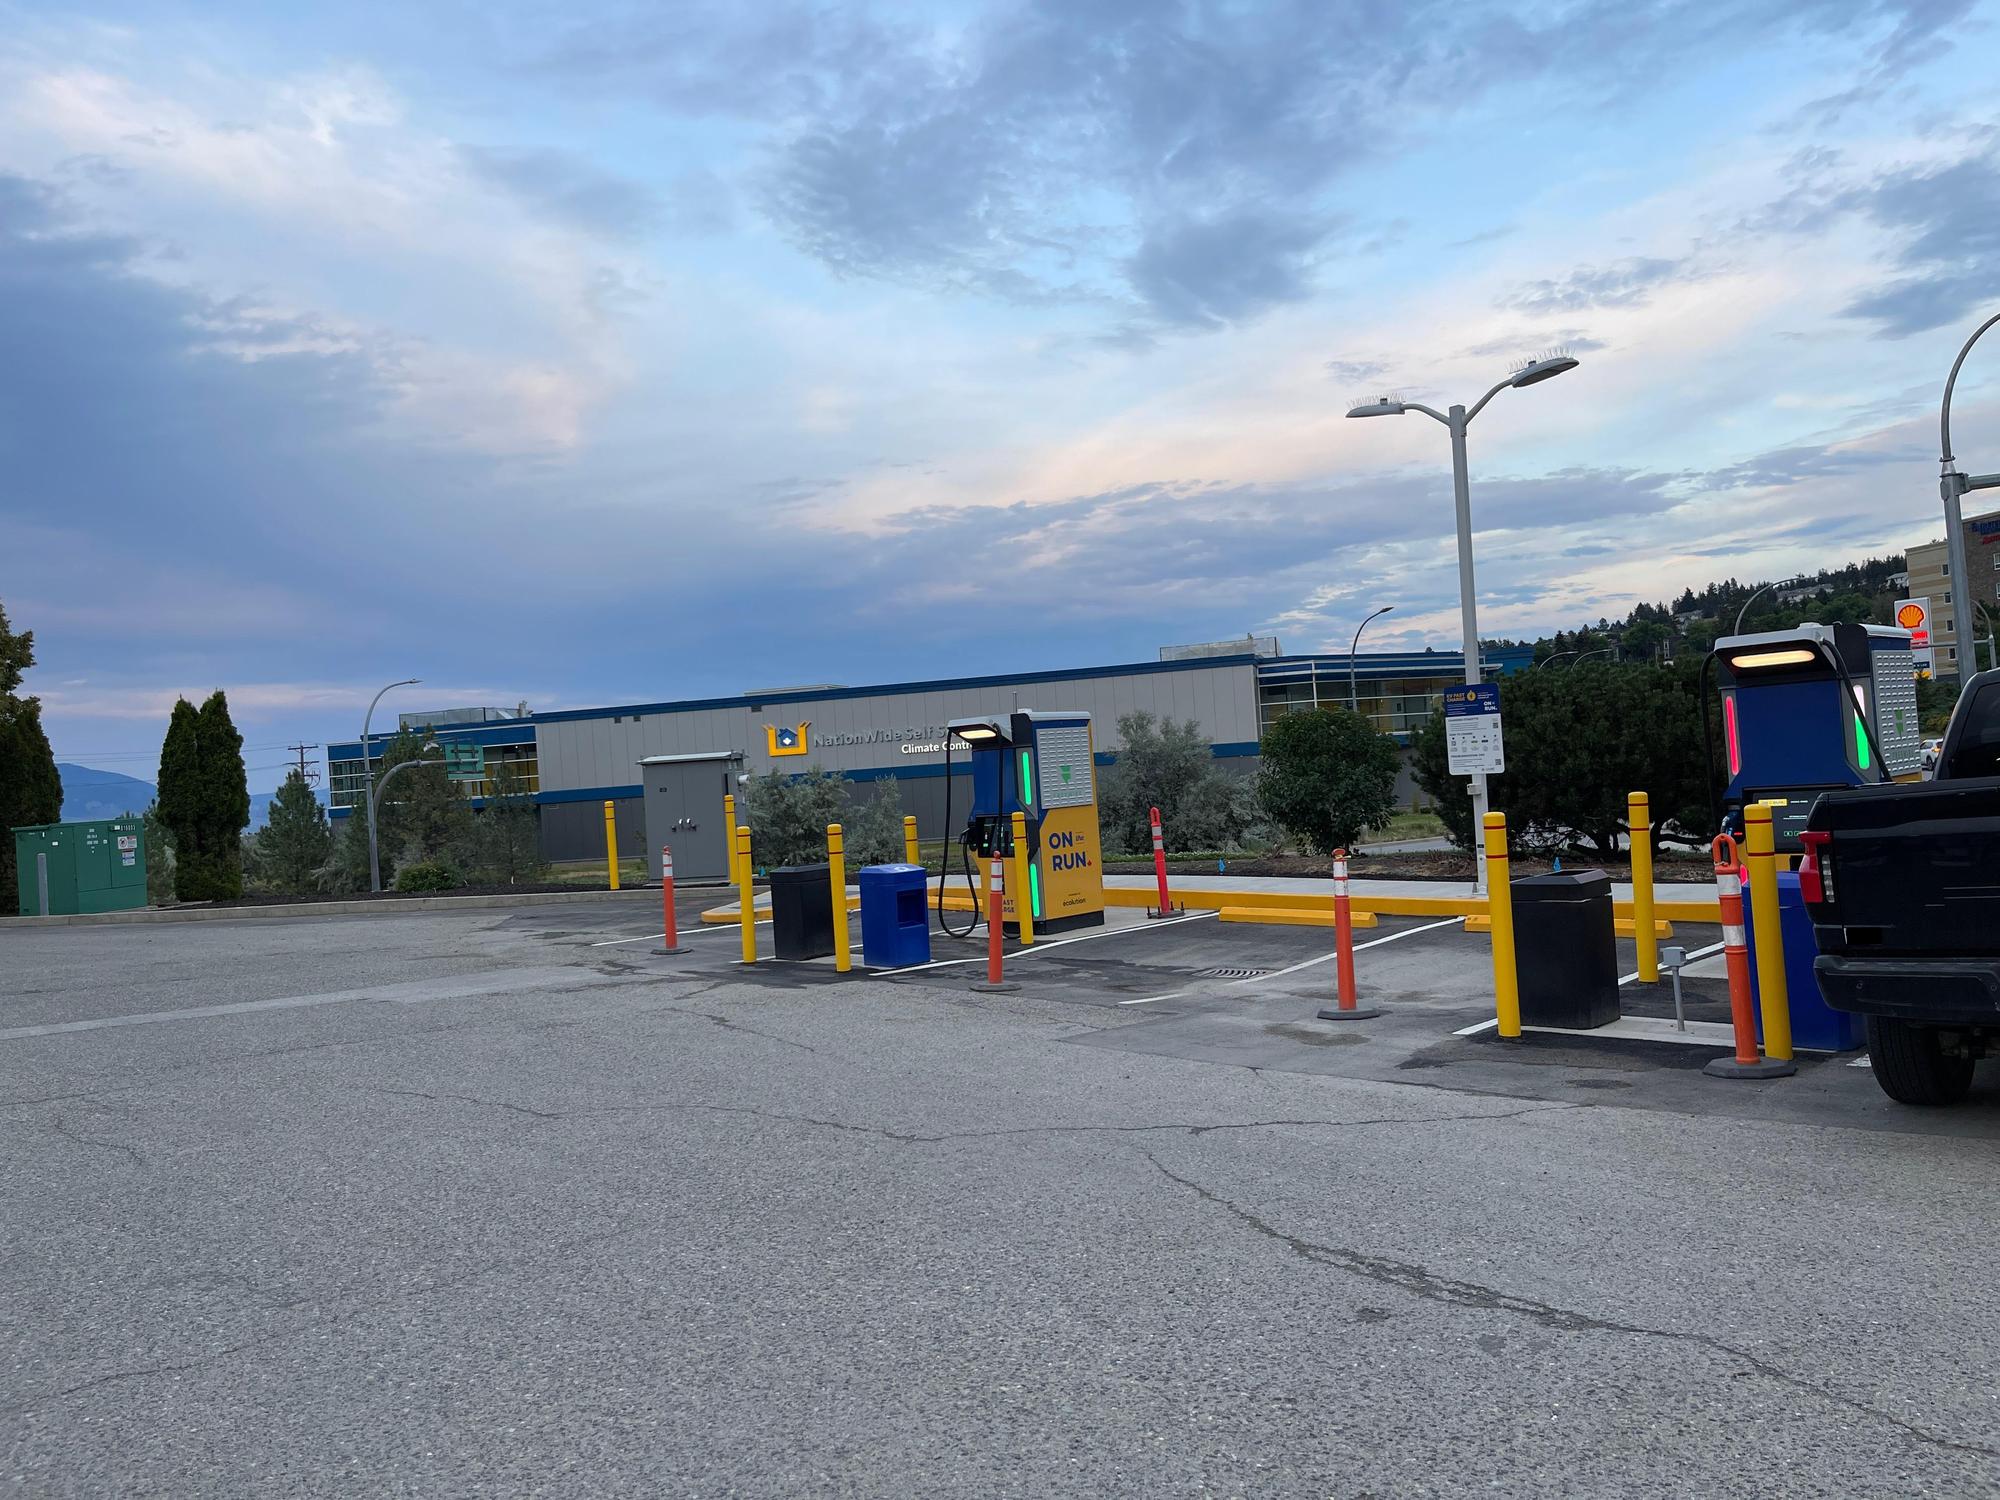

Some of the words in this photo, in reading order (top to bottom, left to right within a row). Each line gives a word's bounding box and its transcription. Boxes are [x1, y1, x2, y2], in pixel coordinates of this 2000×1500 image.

[814, 728, 902, 747] NationWide
[905, 725, 935, 741] Self
[901, 742, 940, 754] Climate
[1049, 831, 1073, 849] ON
